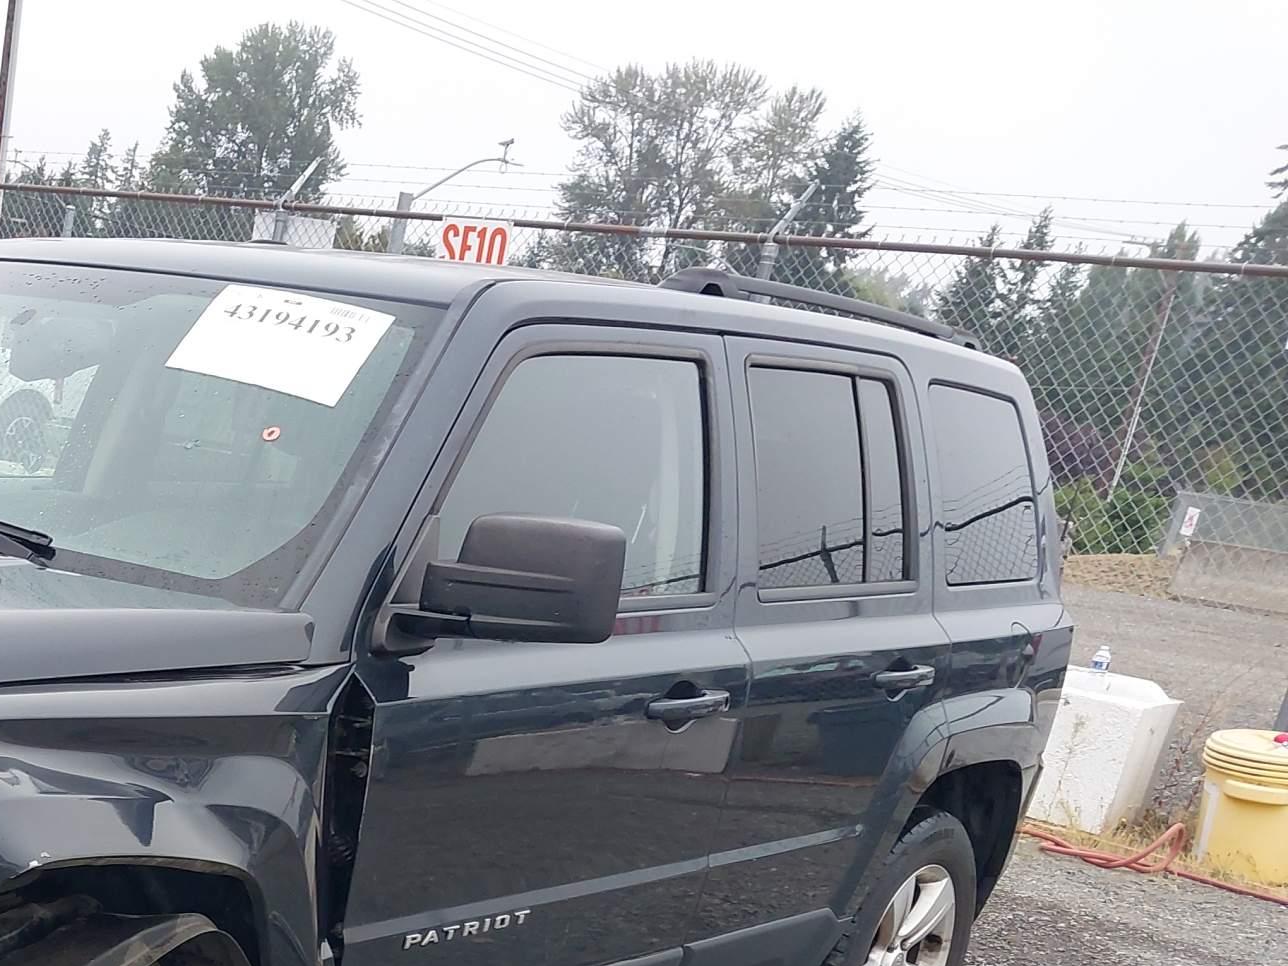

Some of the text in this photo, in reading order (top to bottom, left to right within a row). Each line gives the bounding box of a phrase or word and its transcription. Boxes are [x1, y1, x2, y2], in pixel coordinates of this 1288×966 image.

[439, 223, 507, 265] SF10
[223, 303, 356, 343] 43194193
[403, 909, 531, 950] PATRIOT
